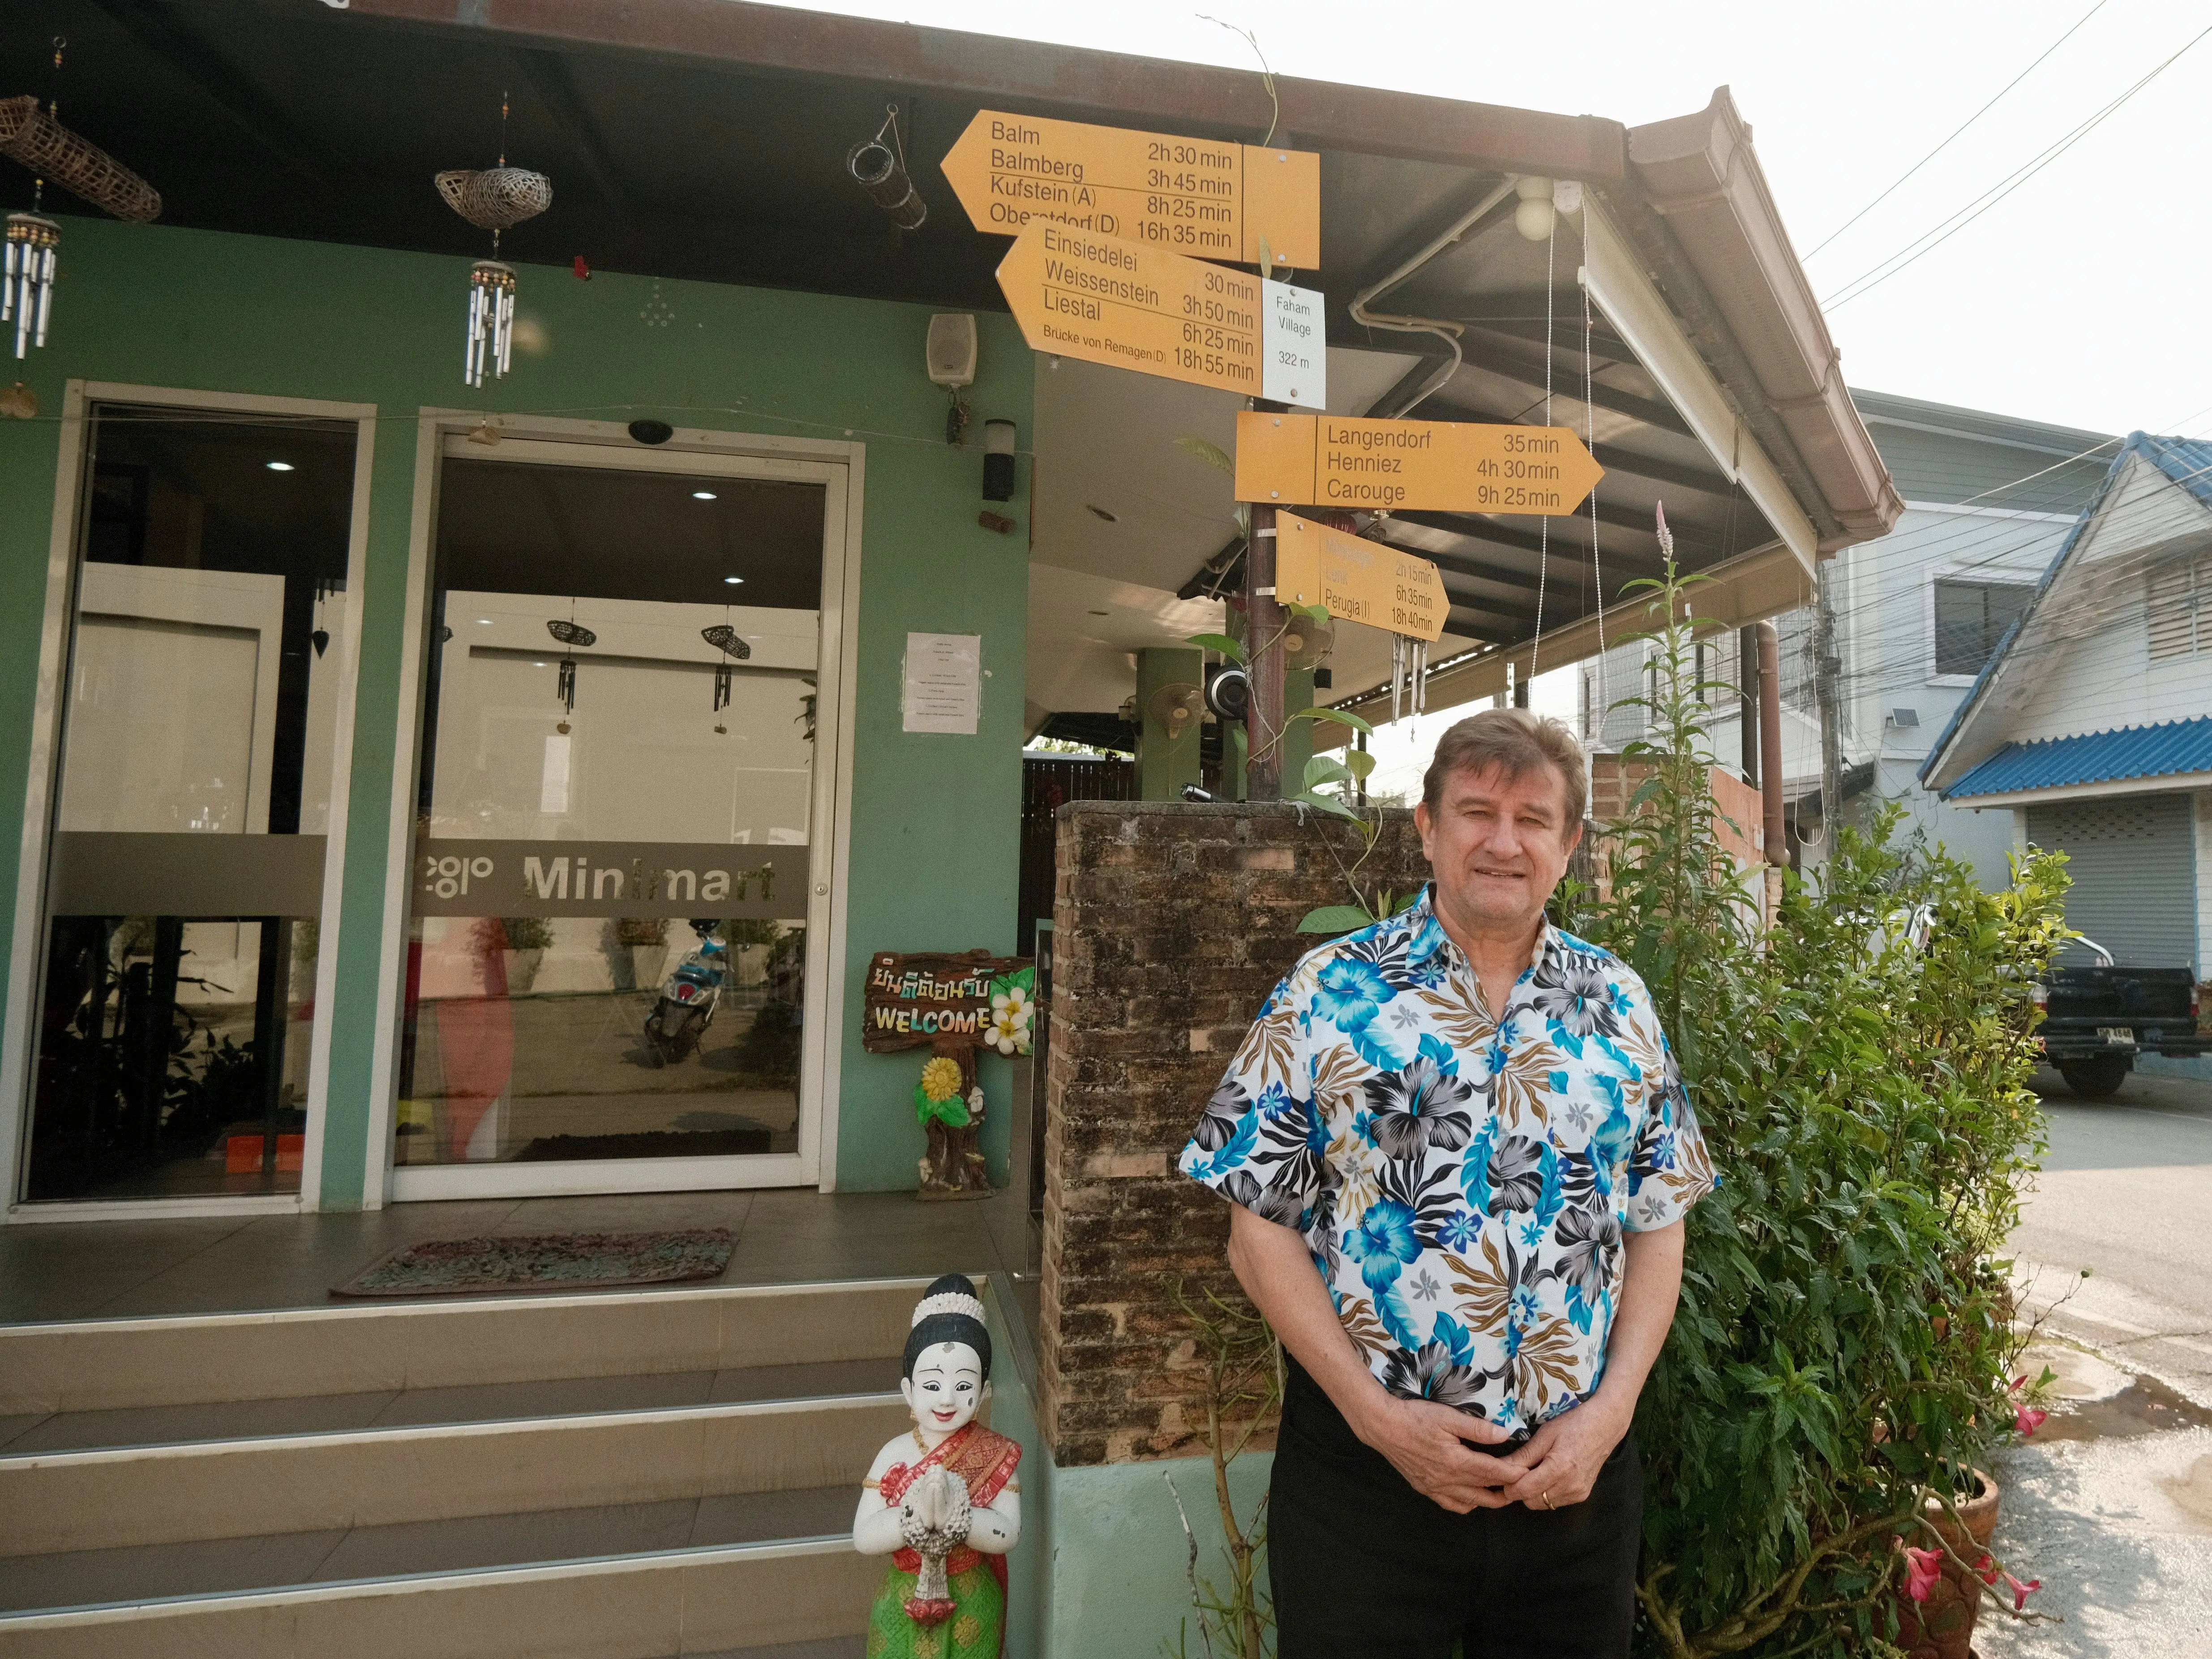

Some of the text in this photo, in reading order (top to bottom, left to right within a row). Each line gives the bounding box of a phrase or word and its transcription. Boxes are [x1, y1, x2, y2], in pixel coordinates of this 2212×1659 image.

[992, 121, 1040, 146] Balm
[1148, 142, 1170, 162] 2h
[992, 148, 1083, 183] Balmberg
[1148, 169, 1170, 189] 3h
[991, 175, 1068, 203] Kufstein
[1147, 196, 1169, 215] 8h
[1138, 220, 1169, 241] 16h
[1045, 228, 1137, 272] Einsiedelei
[1045, 258, 1158, 306] Weissenstein
[1183, 294, 1201, 316] 3h
[1045, 288, 1100, 321] Liestal
[1183, 322, 1201, 344] 6h
[1277, 296, 1310, 316] Faham
[1278, 315, 1311, 338] Village
[1043, 324, 1080, 343] Brücke
[1083, 336, 1101, 349] von
[1175, 347, 1202, 370] 18h
[1279, 351, 1309, 369] 322 m
[1328, 424, 1431, 451] Langendorf
[1328, 451, 1402, 473] Henniez
[1477, 459, 1498, 477] 4h
[1327, 478, 1405, 506] Carouge
[1478, 485, 1499, 504] 9h
[1396, 584, 1406, 602] 6h
[1392, 607, 1406, 626] 18h
[876, 1007, 990, 1034] WELCOME
